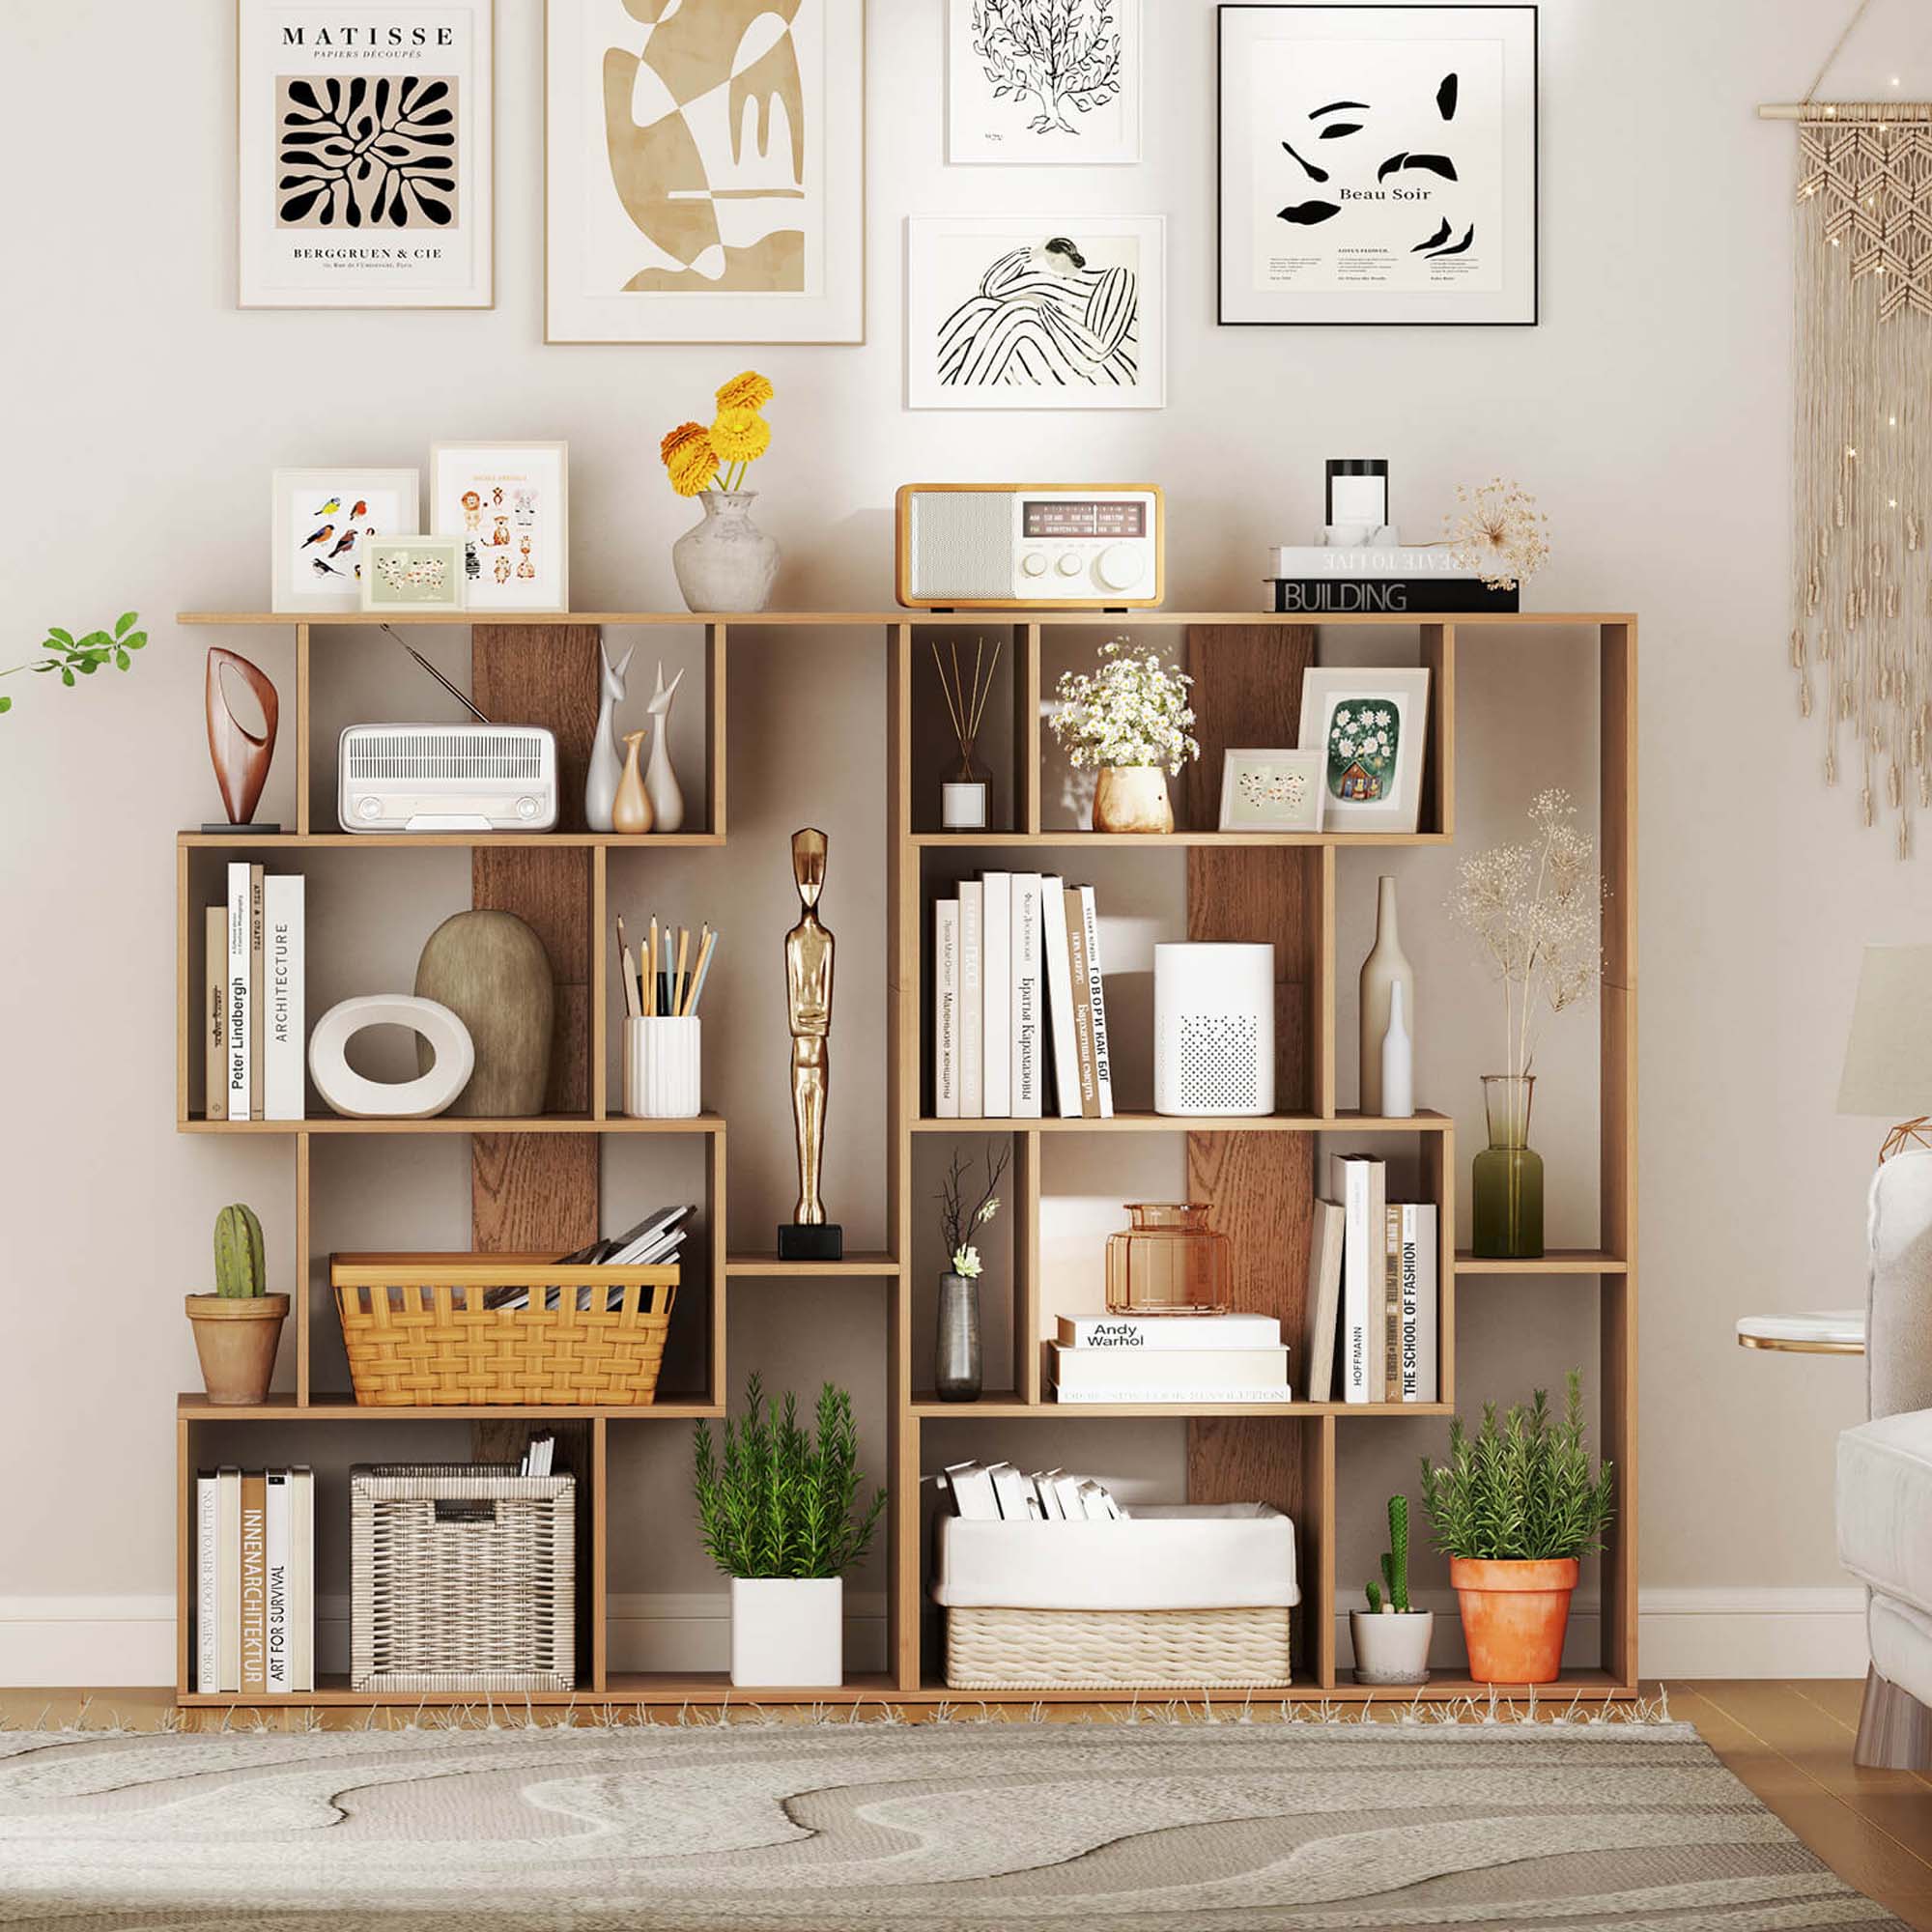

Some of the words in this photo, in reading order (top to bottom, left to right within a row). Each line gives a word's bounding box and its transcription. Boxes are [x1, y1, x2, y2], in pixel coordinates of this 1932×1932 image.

[282, 27, 453, 45] MATISSE
[313, 50, 358, 59] PAPIERS
[1340, 188, 1385, 200] Beau
[1392, 187, 1432, 200] Soir
[294, 248, 390, 259] BERGGRUEN
[397, 248, 408, 259] &
[413, 248, 442, 259] CIE
[1284, 582, 1407, 611] BUILDING
[274, 923, 289, 1043] ARCHITECTURE
[1018, 977, 1035, 1021] Братья
[1090, 966, 1103, 1029] ГОВОРИ
[231, 976, 247, 1049] Lindbergh
[1094, 1031, 1107, 1056] КАК
[231, 1052, 244, 1090] Peter
[1018, 1024, 1035, 1100] Карамазовы
[1097, 1061, 1109, 1083] БОГ
[1404, 1241, 1415, 1295] FASHION
[1404, 1296, 1415, 1316] OF
[1087, 1335, 1145, 1347] Warhol
[1094, 1323, 1138, 1338] Andy
[1404, 1317, 1415, 1368] SCHOOL
[1352, 1325, 1362, 1387] HOFFMANN
[1404, 1370, 1415, 1396] THE
[242, 1508, 264, 1683] INNENARCHITEKTUR
[270, 1565, 285, 1623] SURVIVAL
[270, 1626, 285, 1653] FOR
[270, 1656, 285, 1682] ART
